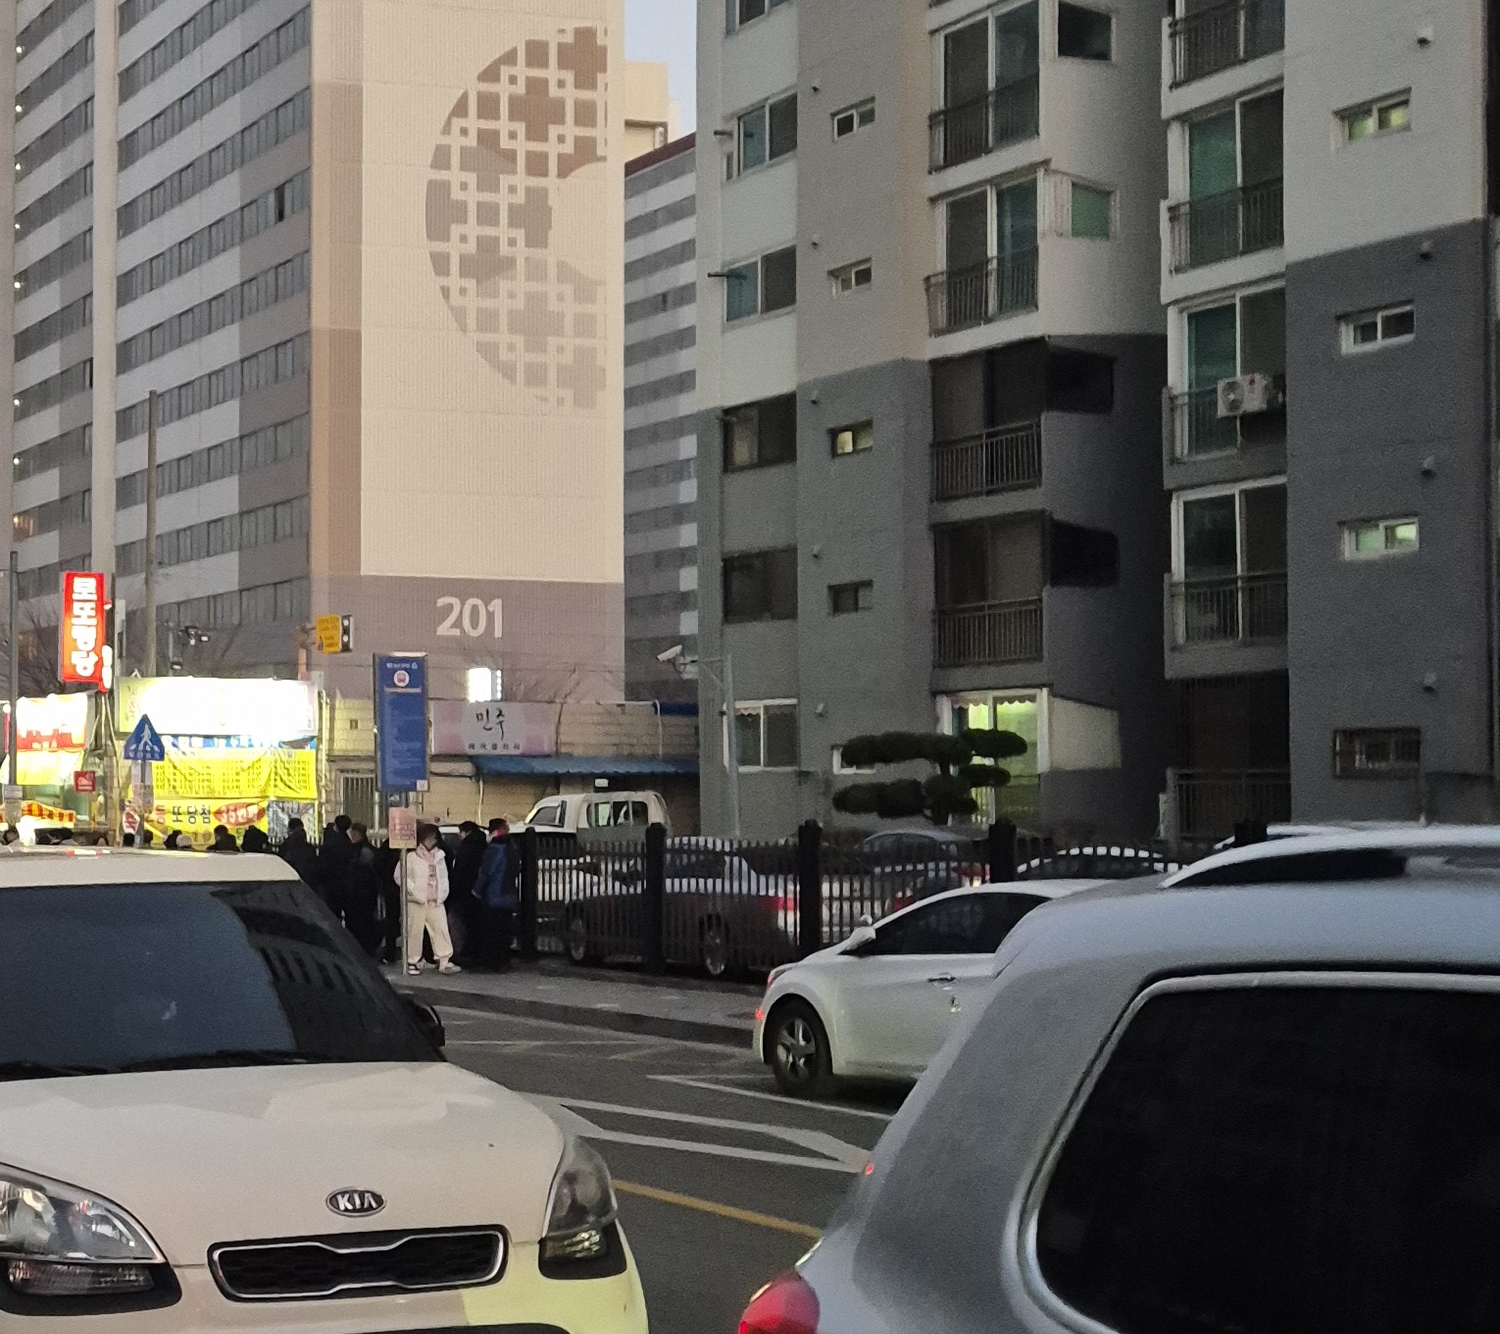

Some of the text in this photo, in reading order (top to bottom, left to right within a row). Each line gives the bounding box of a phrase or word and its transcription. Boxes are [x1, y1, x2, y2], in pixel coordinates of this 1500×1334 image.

[70, 576, 100, 677] 로또명당
[435, 596, 504, 639] 201
[475, 707, 506, 741] 민주
[335, 1192, 379, 1211] KIA
